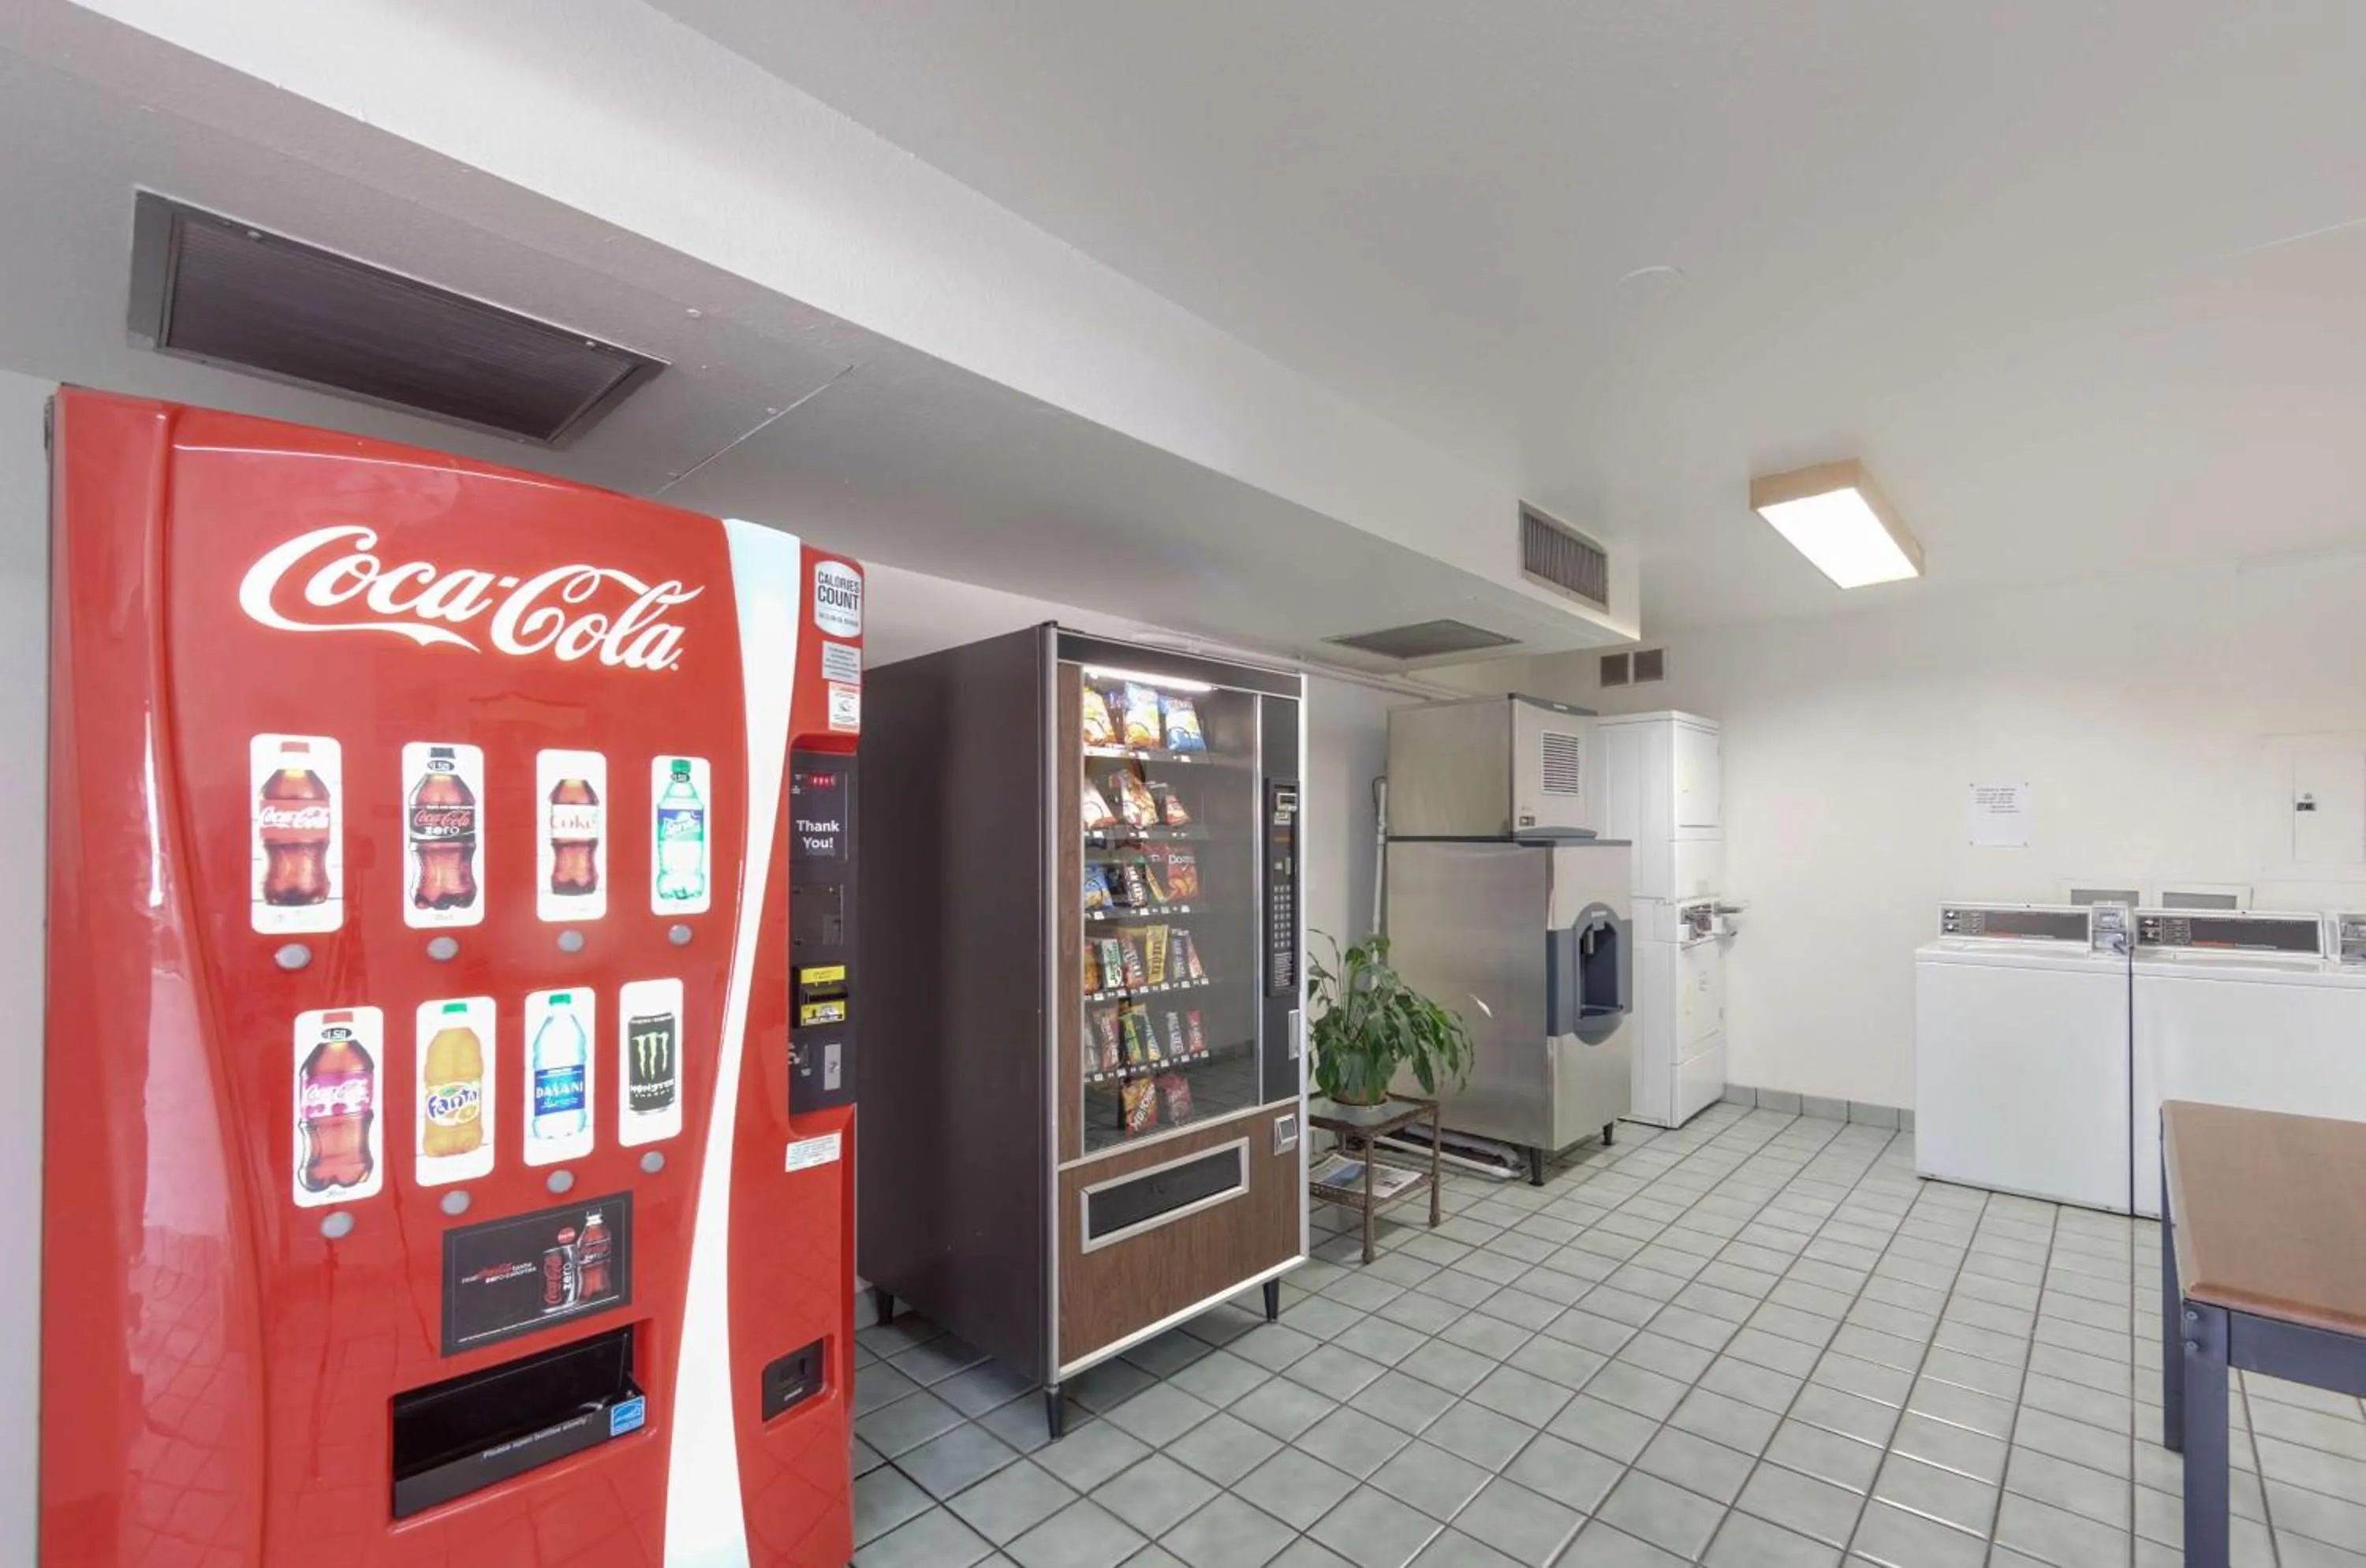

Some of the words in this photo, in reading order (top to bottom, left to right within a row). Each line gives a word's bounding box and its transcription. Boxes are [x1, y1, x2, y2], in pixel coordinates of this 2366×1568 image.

[818, 570, 860, 593] CALORIES
[239, 525, 706, 670] Coca-Cola
[818, 585, 859, 610] COUNT
[796, 819, 840, 833] Thank
[803, 837, 834, 849] You!
